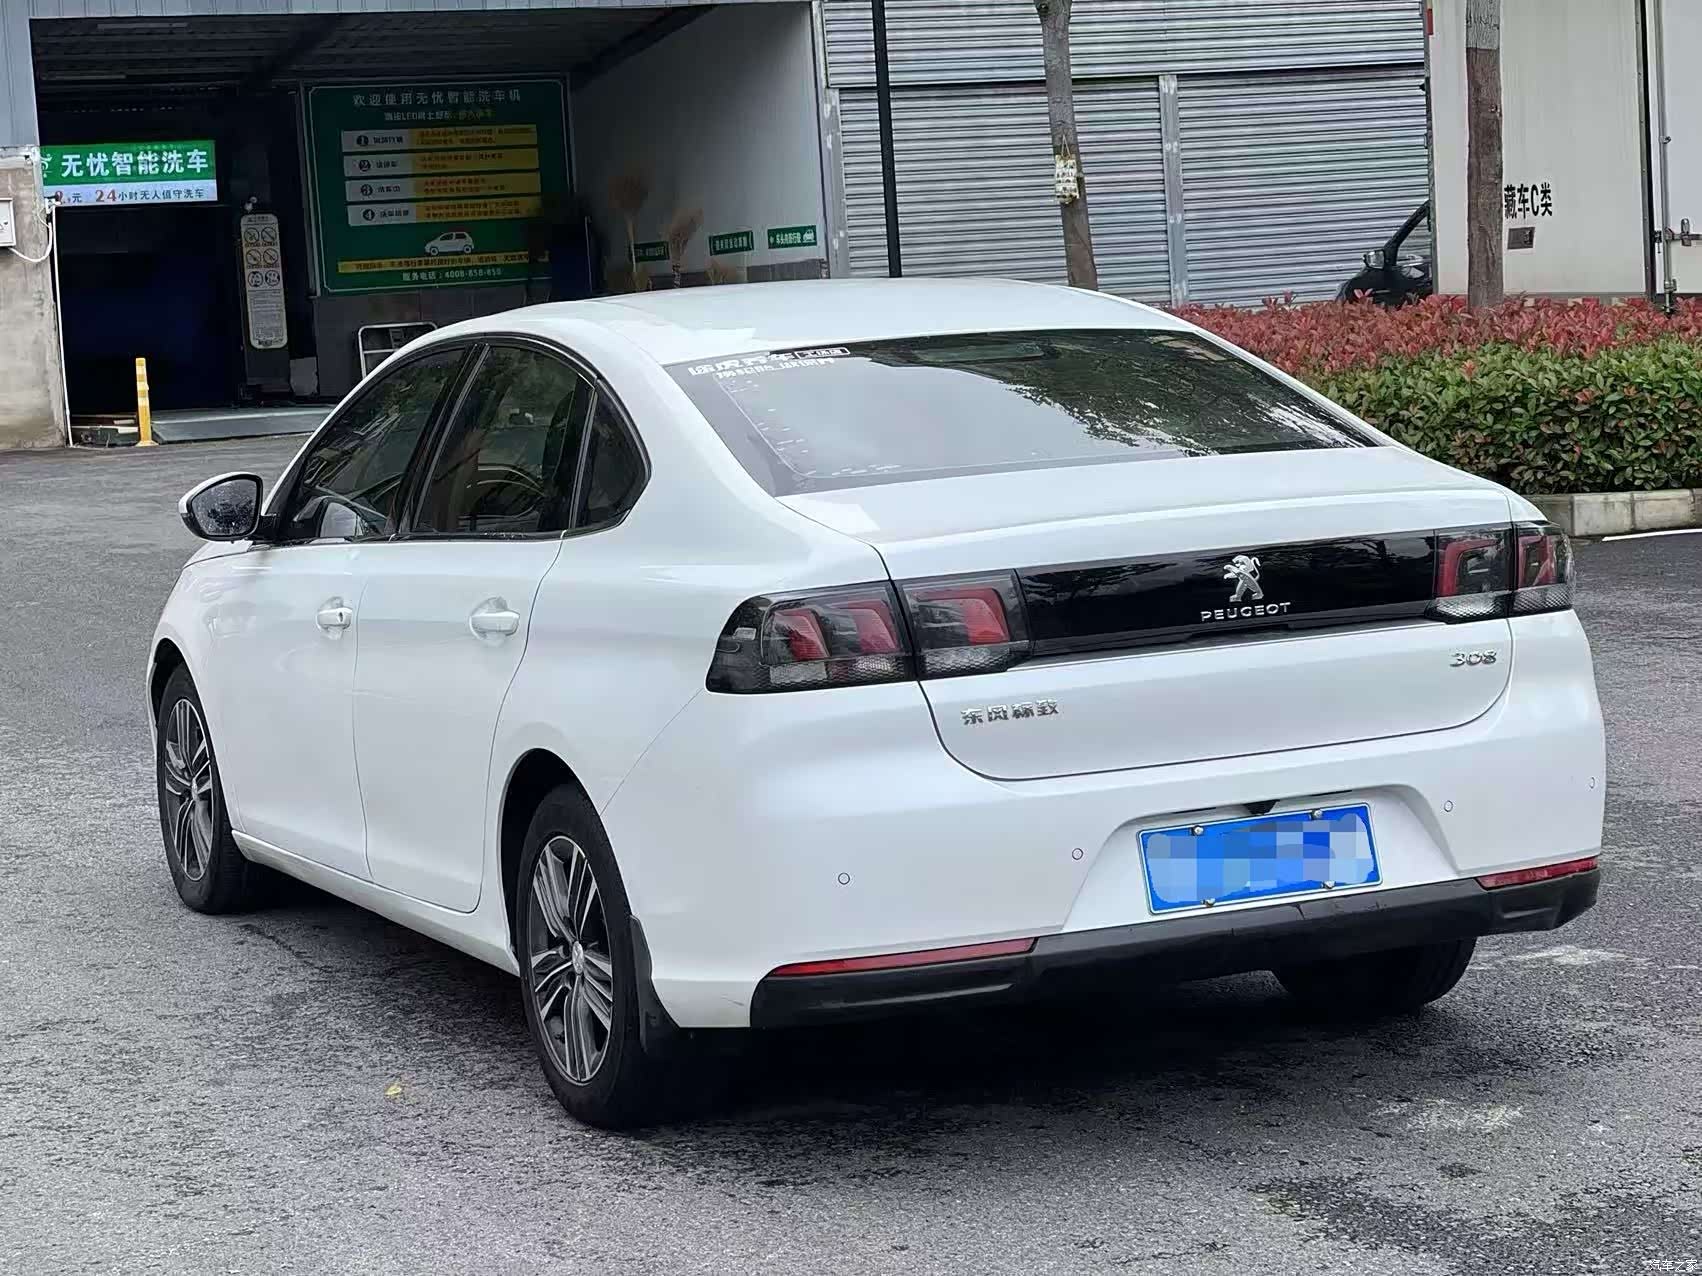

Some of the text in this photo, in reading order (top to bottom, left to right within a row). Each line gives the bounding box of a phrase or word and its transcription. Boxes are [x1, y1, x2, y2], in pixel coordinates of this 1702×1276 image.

[61, 149, 209, 178] 无忧智能洗车
[1200, 602, 1291, 621] PEUGEOT
[1450, 649, 1497, 667] 308
[960, 699, 1059, 725] 东风标致
